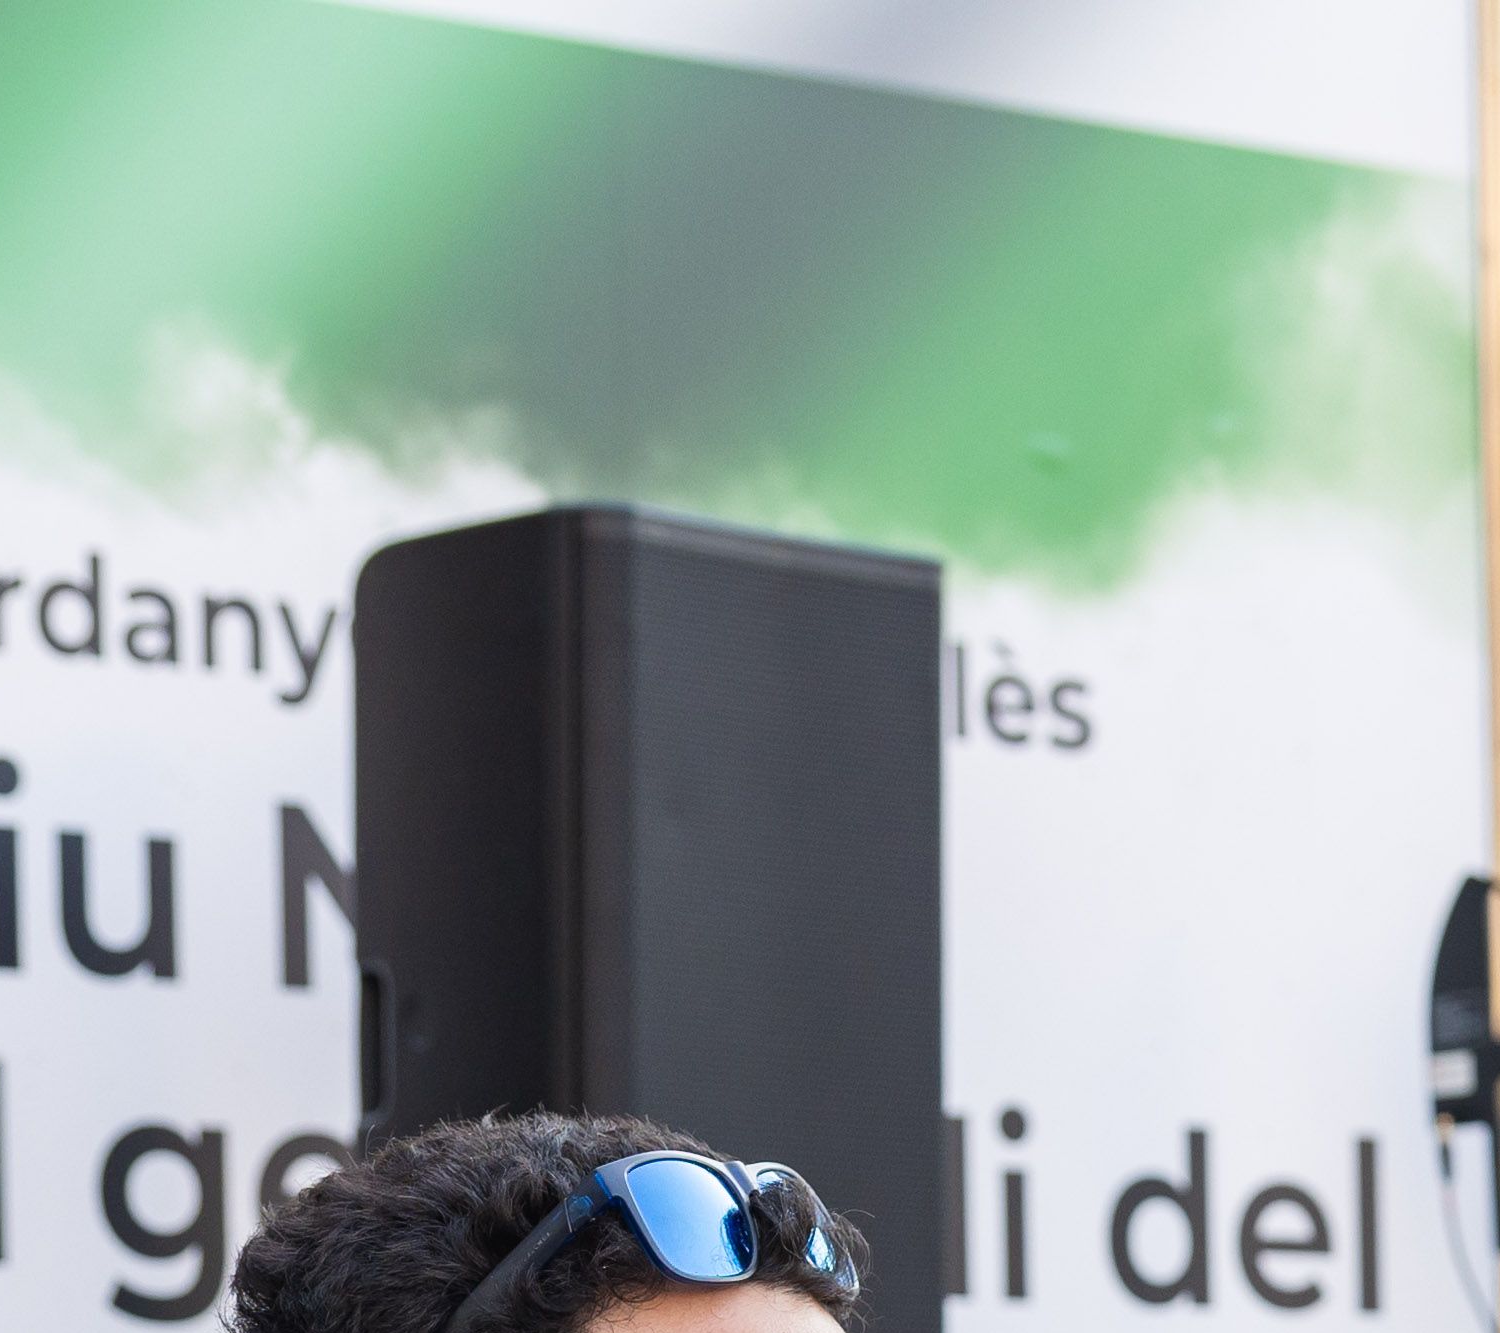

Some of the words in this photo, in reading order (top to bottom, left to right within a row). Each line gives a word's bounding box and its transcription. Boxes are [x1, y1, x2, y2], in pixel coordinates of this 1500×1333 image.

[950, 640, 1092, 749] lès
[281, 803, 358, 988] N
[1111, 1130, 1377, 1311] del
